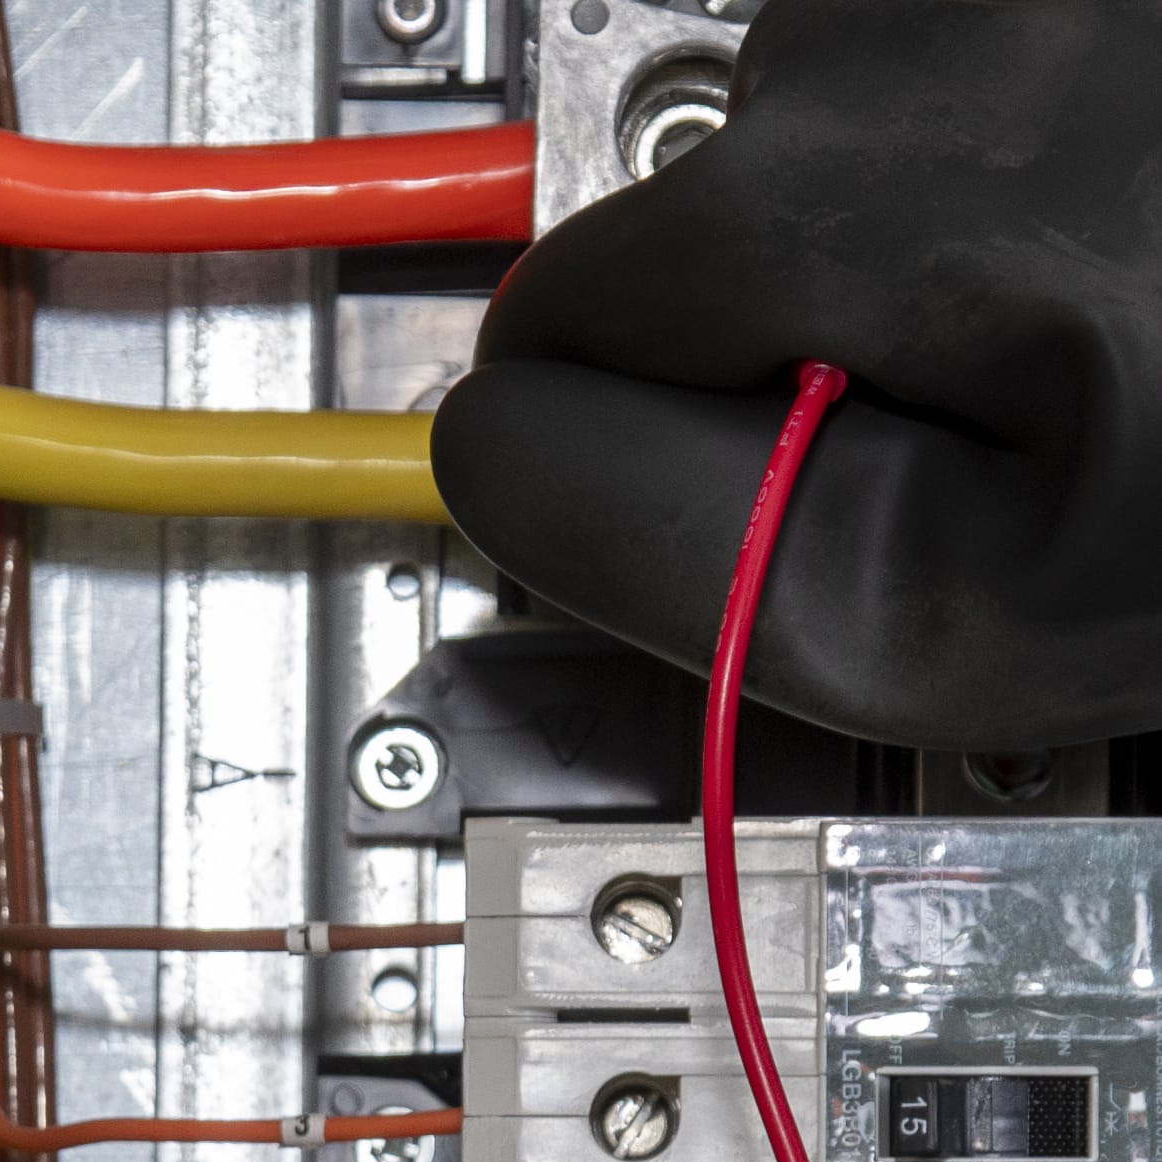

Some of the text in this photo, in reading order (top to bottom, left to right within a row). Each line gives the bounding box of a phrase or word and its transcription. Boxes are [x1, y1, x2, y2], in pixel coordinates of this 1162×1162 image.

[299, 925, 311, 950] 1
[1004, 1032, 1015, 1064] TRIP
[1057, 1030, 1071, 1057] ON
[295, 1114, 310, 1137] 3
[899, 1096, 928, 1136] 15
